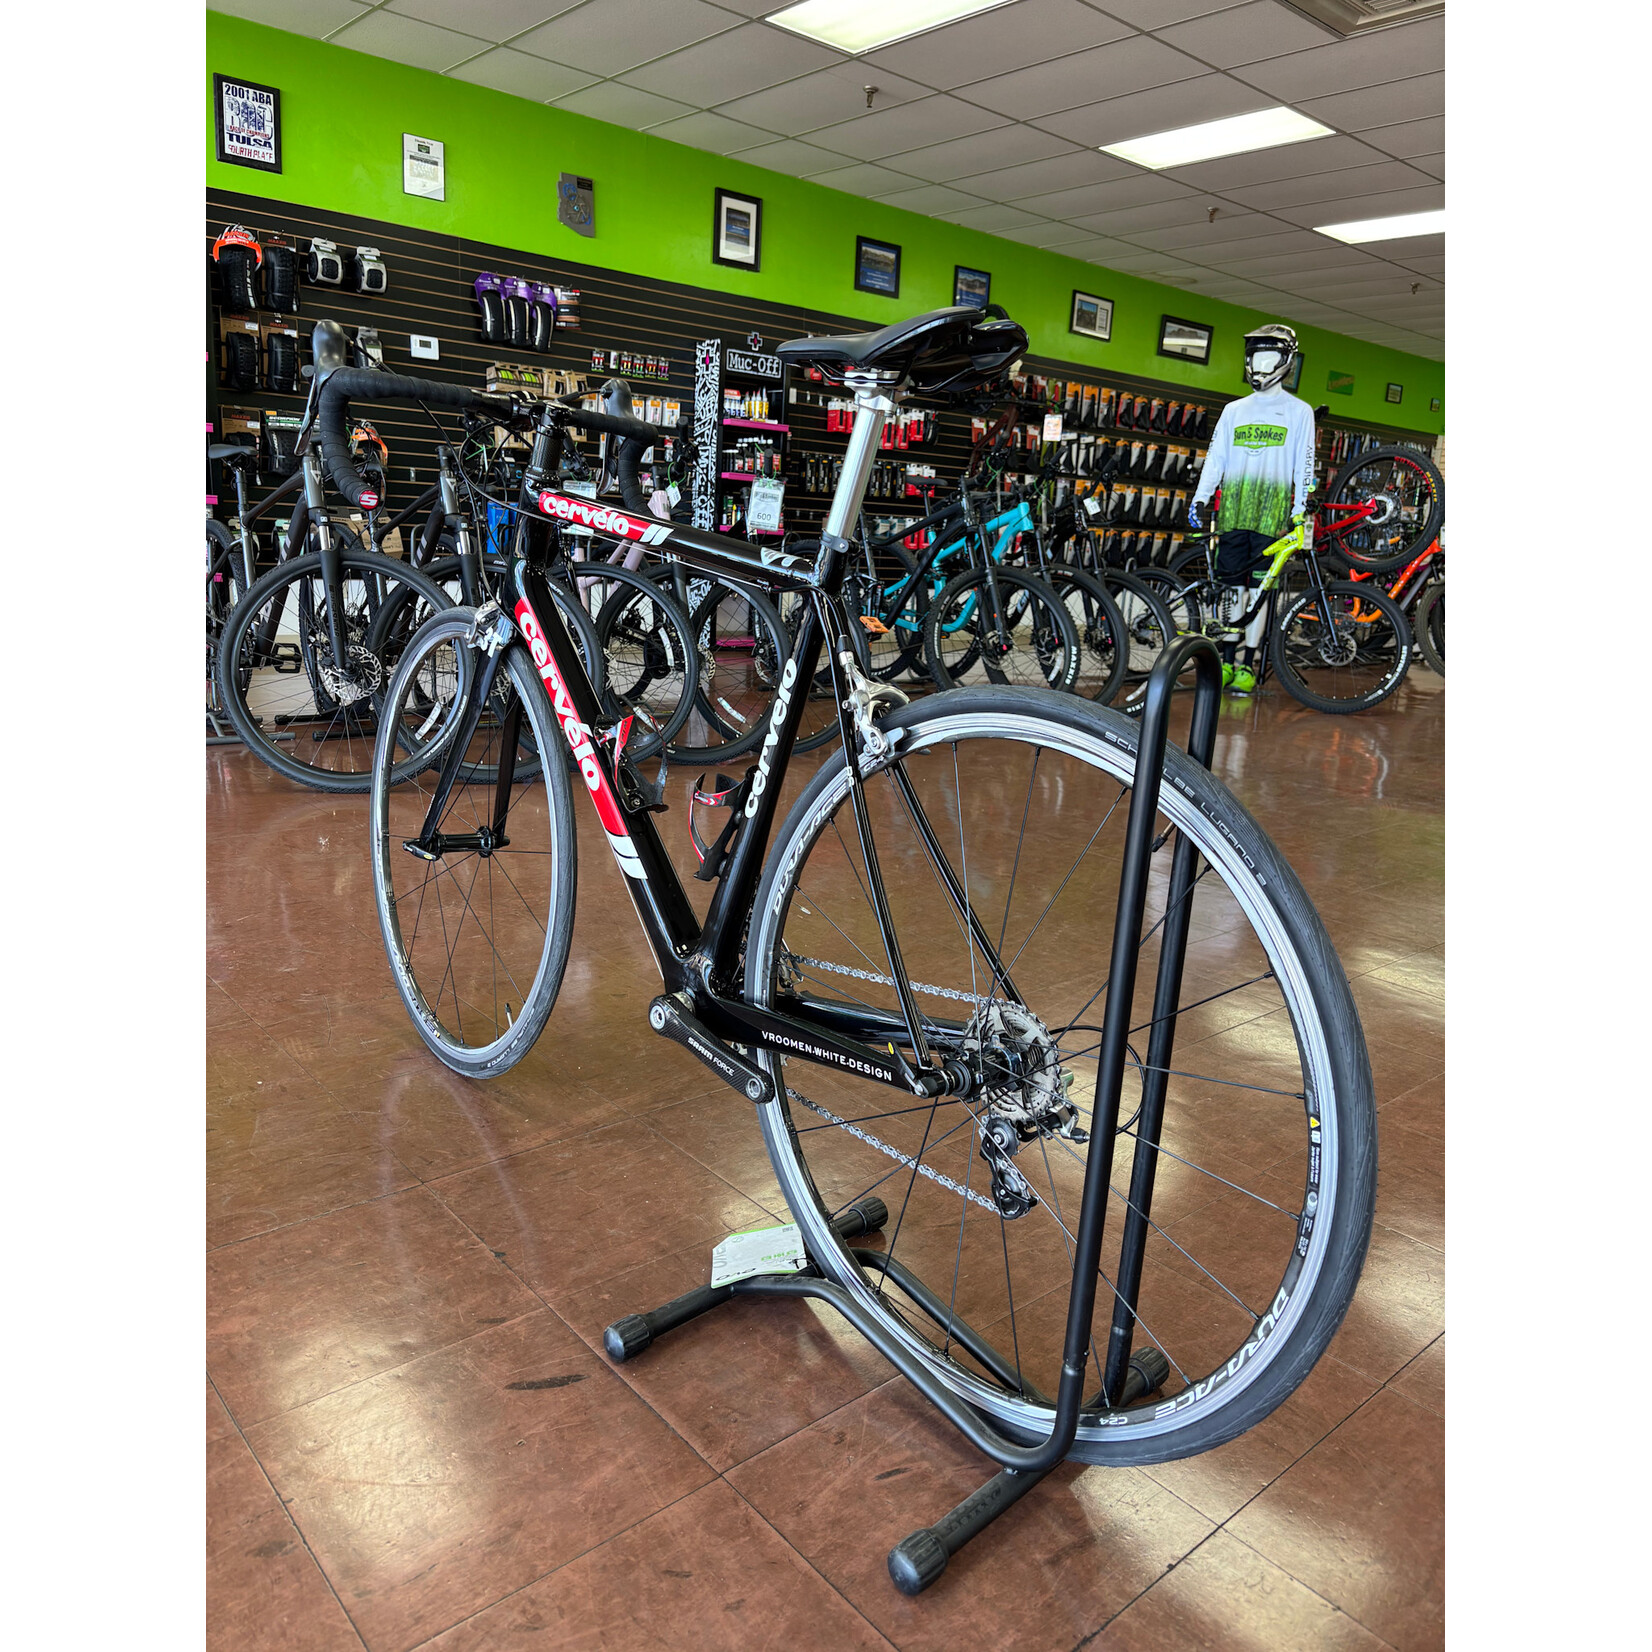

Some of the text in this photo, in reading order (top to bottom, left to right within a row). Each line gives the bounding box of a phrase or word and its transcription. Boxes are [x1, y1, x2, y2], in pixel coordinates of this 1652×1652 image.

[225, 84, 272, 106] 2001 ABA
[226, 132, 273, 150] TULSA
[729, 352, 780, 375] Muc-Off
[1254, 426, 1284, 442] Spokes
[757, 512, 772, 521] 600
[1065, 645, 1078, 685] MAXXIS
[863, 754, 884, 772] C24
[1200, 802, 1256, 869] LUGANO
[773, 781, 847, 915] DURA-ACE
[687, 1036, 735, 1077] SRAM FORCE
[1155, 1286, 1289, 1420] DURA-ACE
[1099, 1416, 1128, 1425] C24
